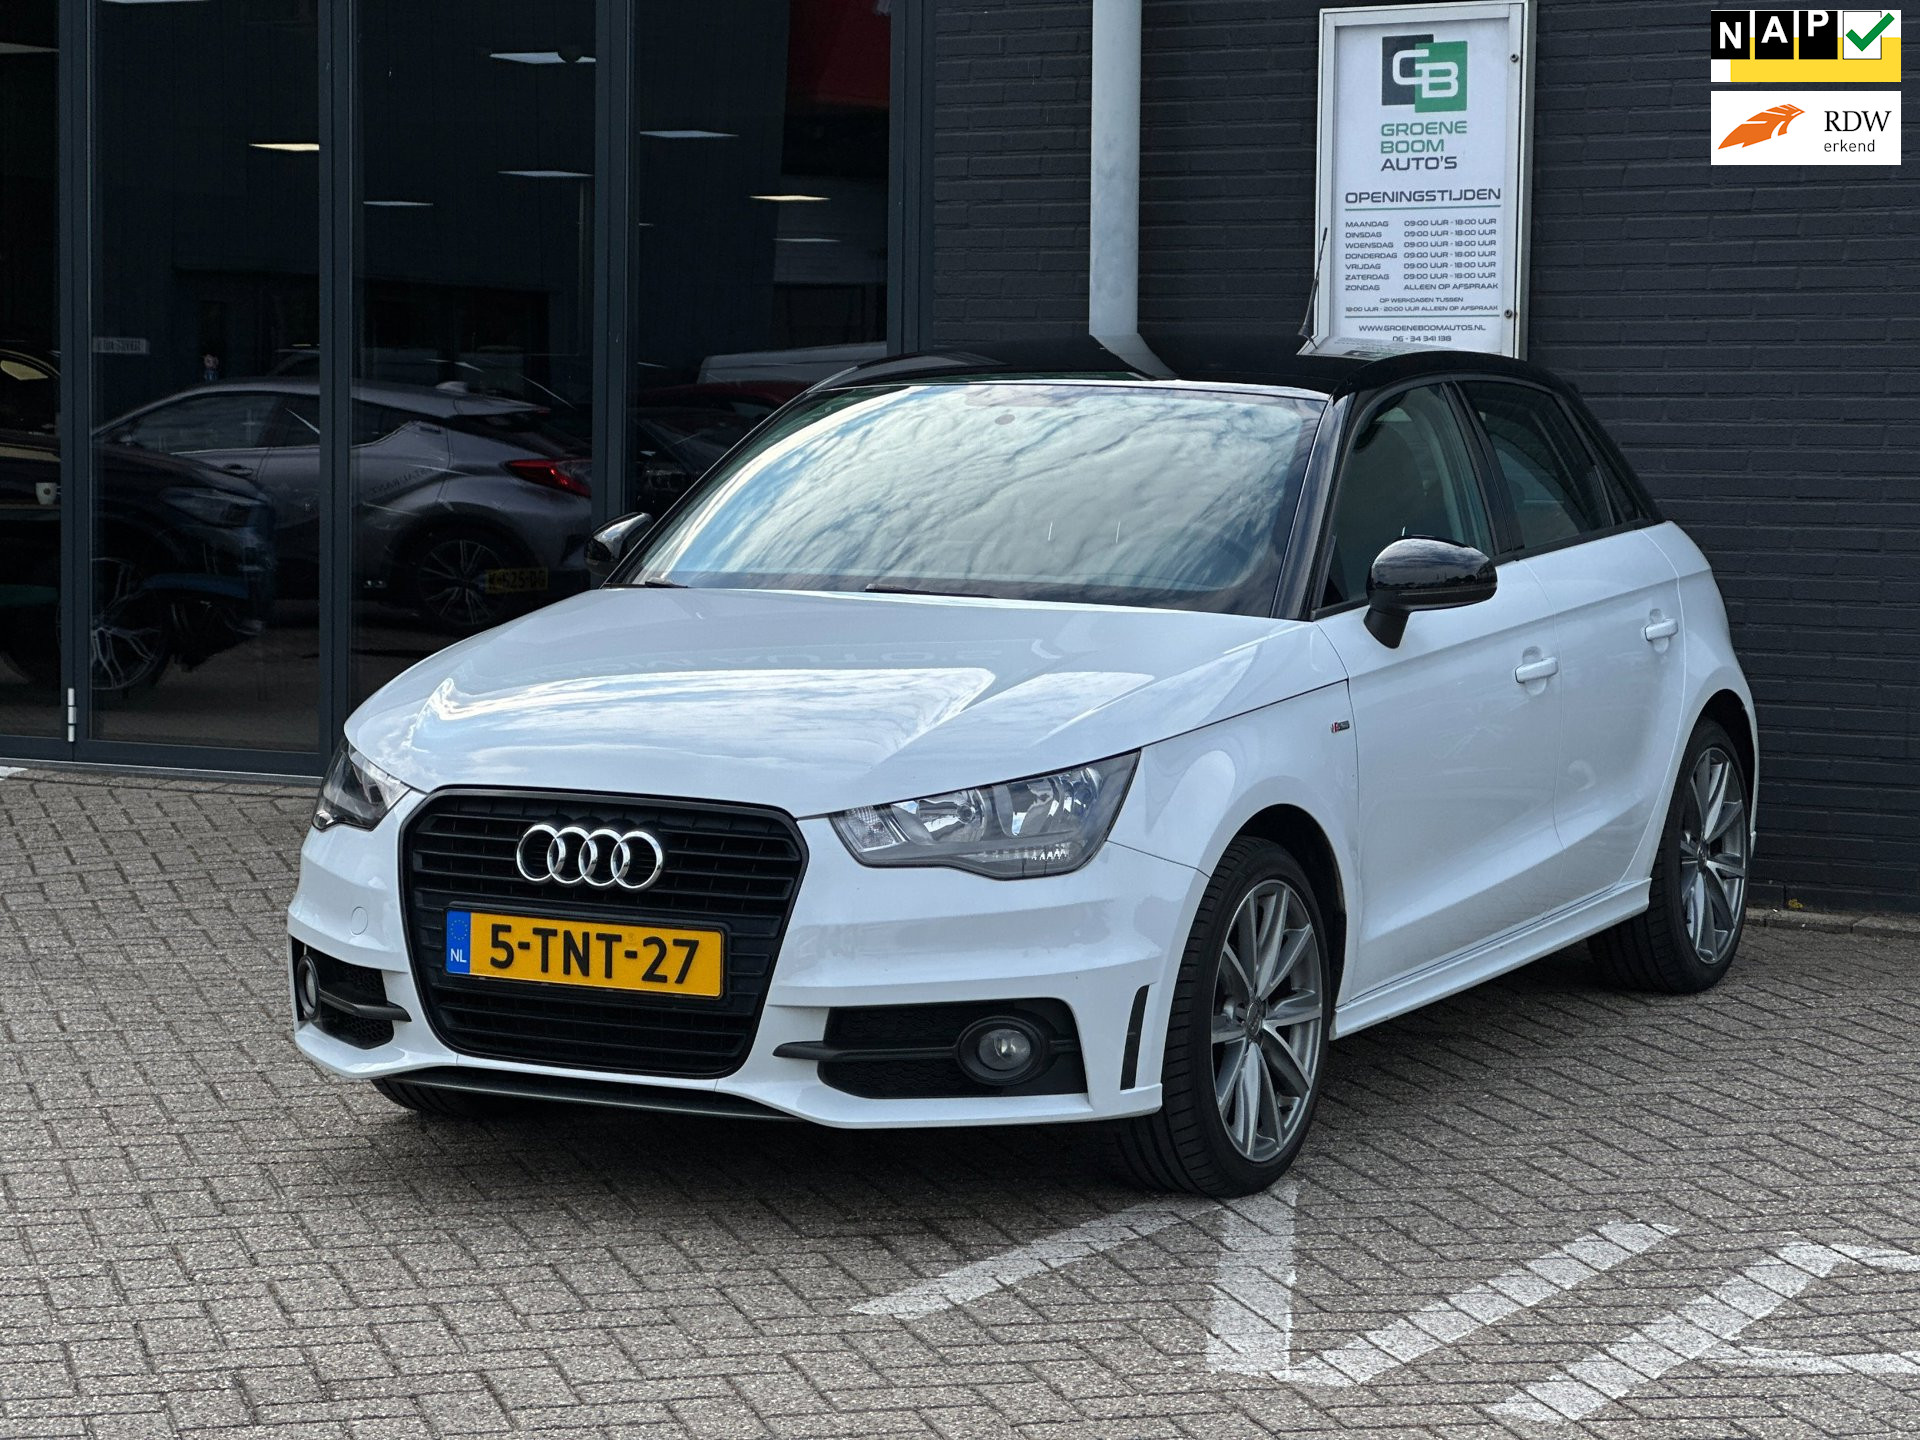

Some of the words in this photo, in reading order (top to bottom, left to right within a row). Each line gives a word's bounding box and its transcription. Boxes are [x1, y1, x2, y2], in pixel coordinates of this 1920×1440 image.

[1381, 121, 1467, 136] GROENE
[1381, 139, 1444, 154] BOOM
[1381, 156, 1457, 171] AUTO'S
[1345, 188, 1501, 204] OPENINGSTIJDEN
[450, 948, 467, 963] NL
[490, 923, 700, 985] 5-TNT-27
